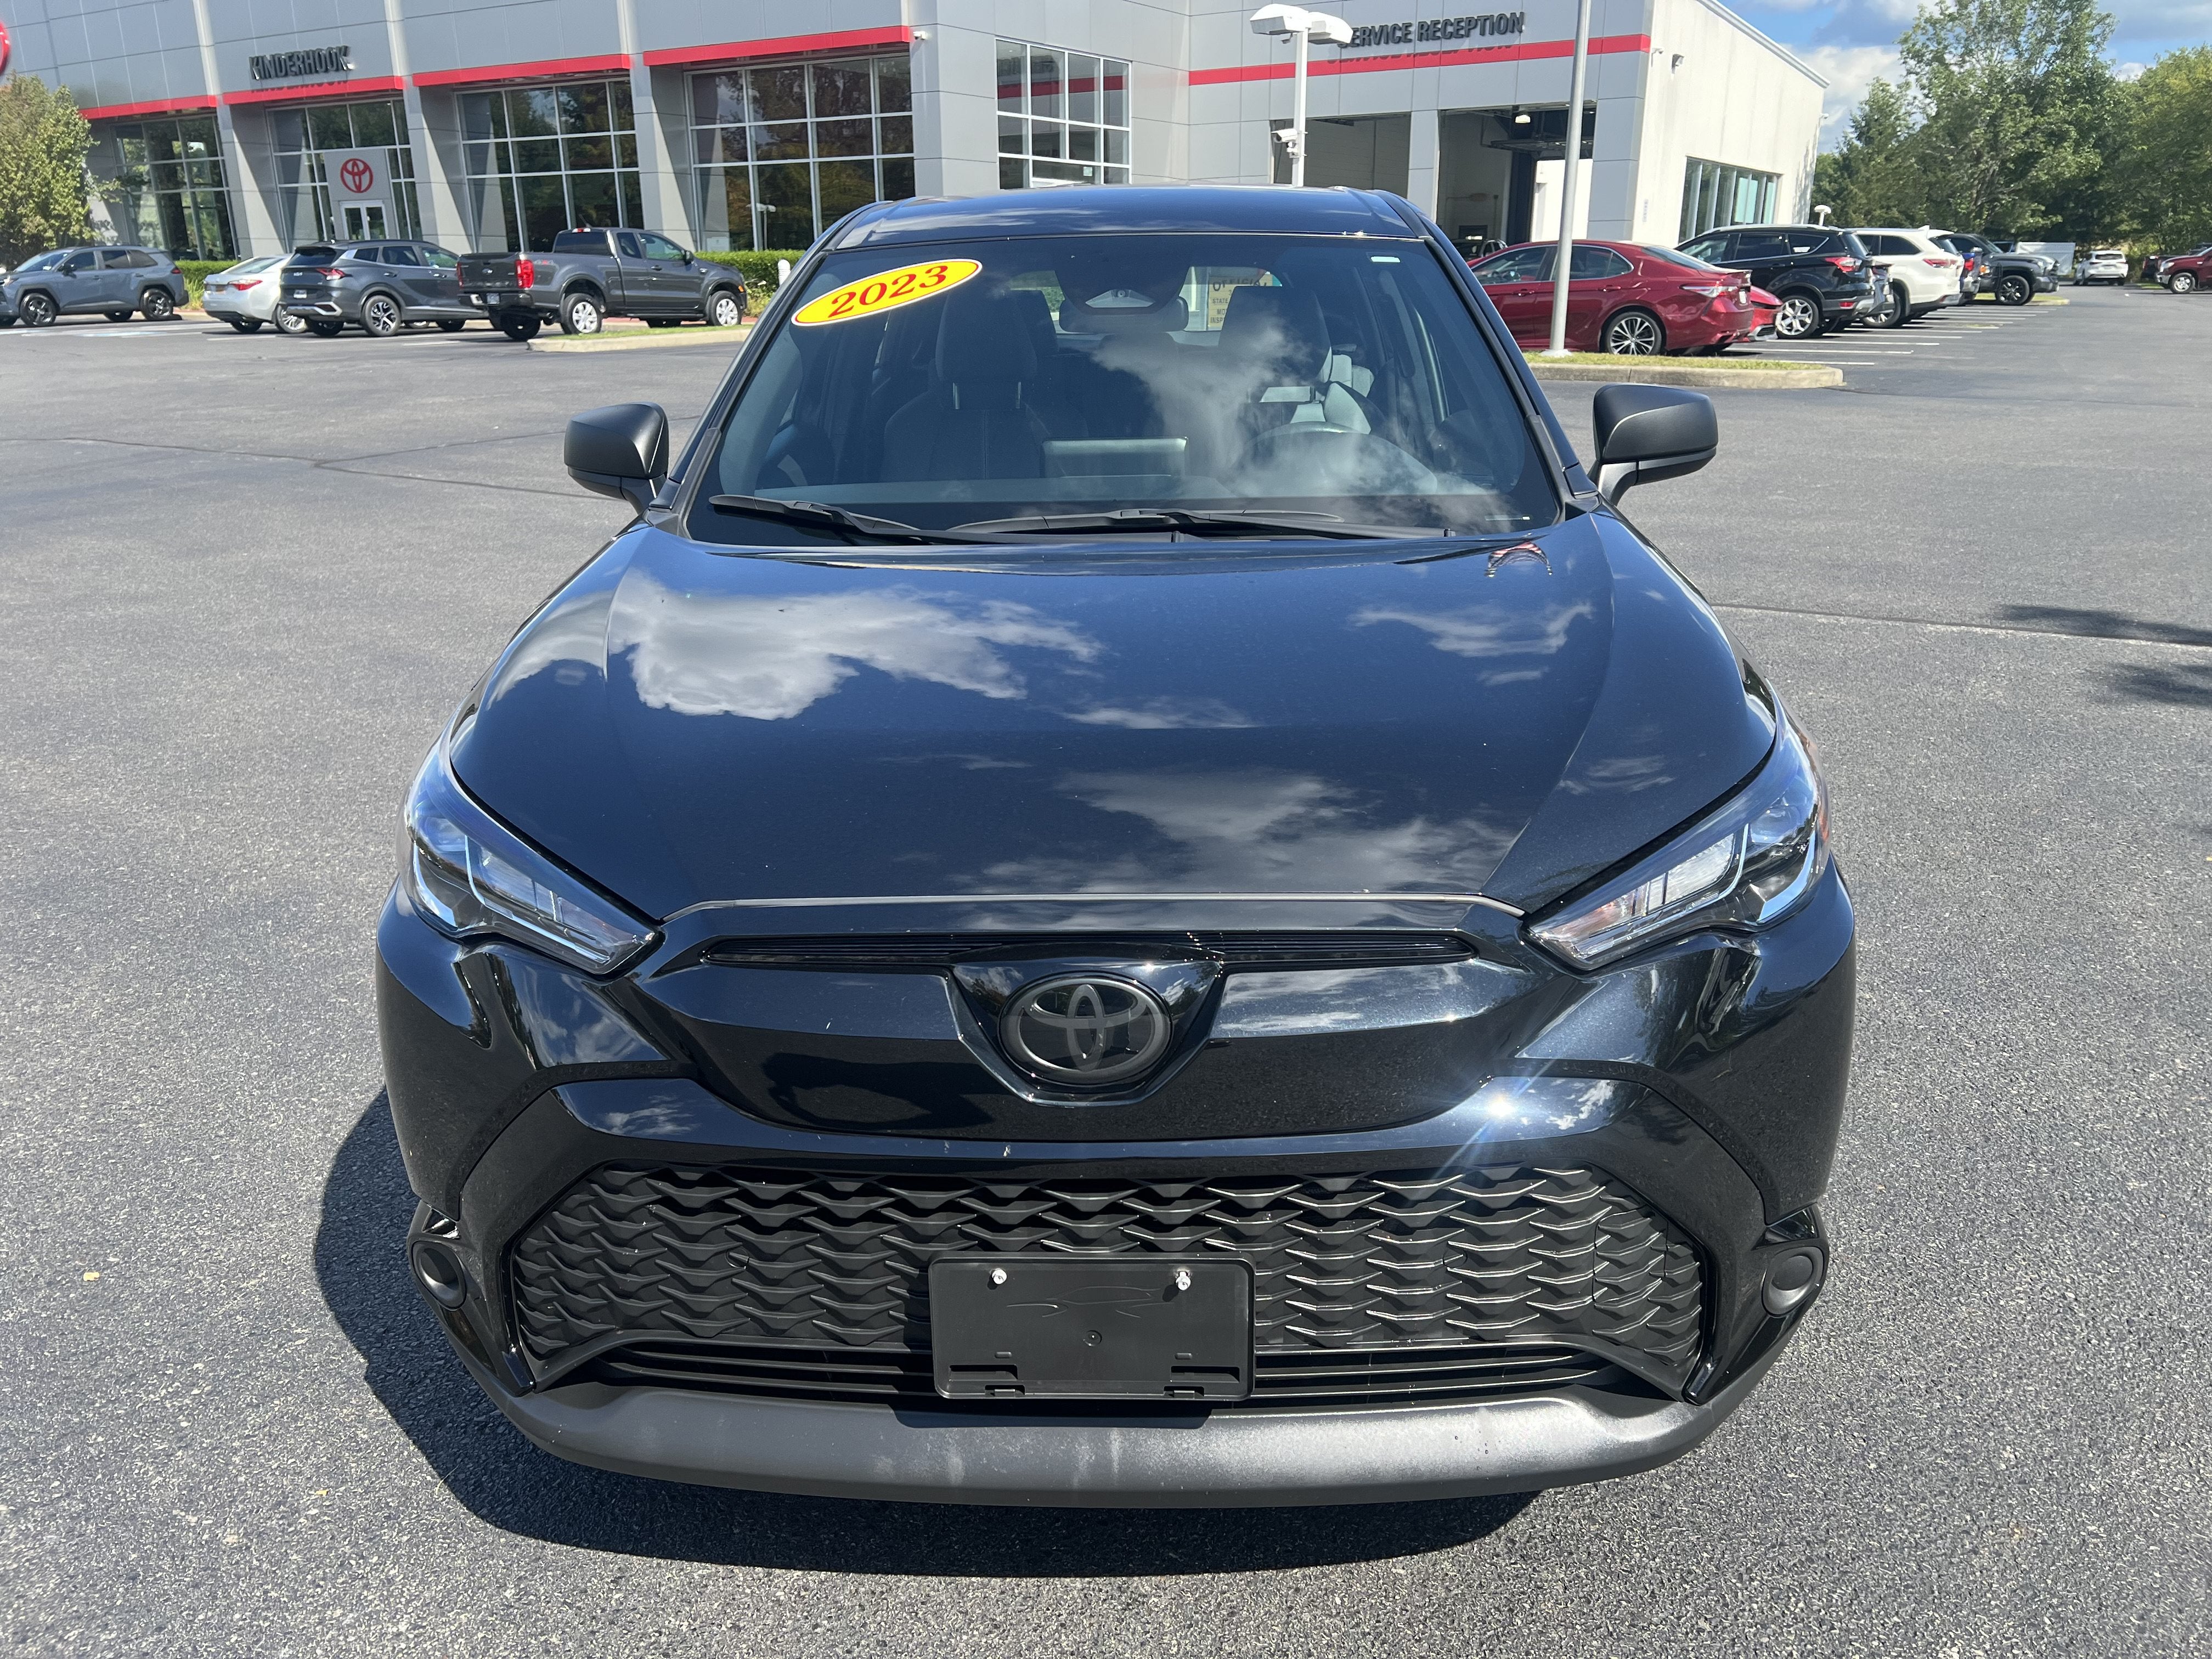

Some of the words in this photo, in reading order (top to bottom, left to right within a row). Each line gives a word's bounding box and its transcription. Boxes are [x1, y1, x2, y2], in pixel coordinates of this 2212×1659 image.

[1339, 22, 1413, 48] ERVICE
[1417, 12, 1525, 42] RECEPTION
[249, 46, 351, 80] KINDERHOOK
[828, 266, 948, 318] 2023
